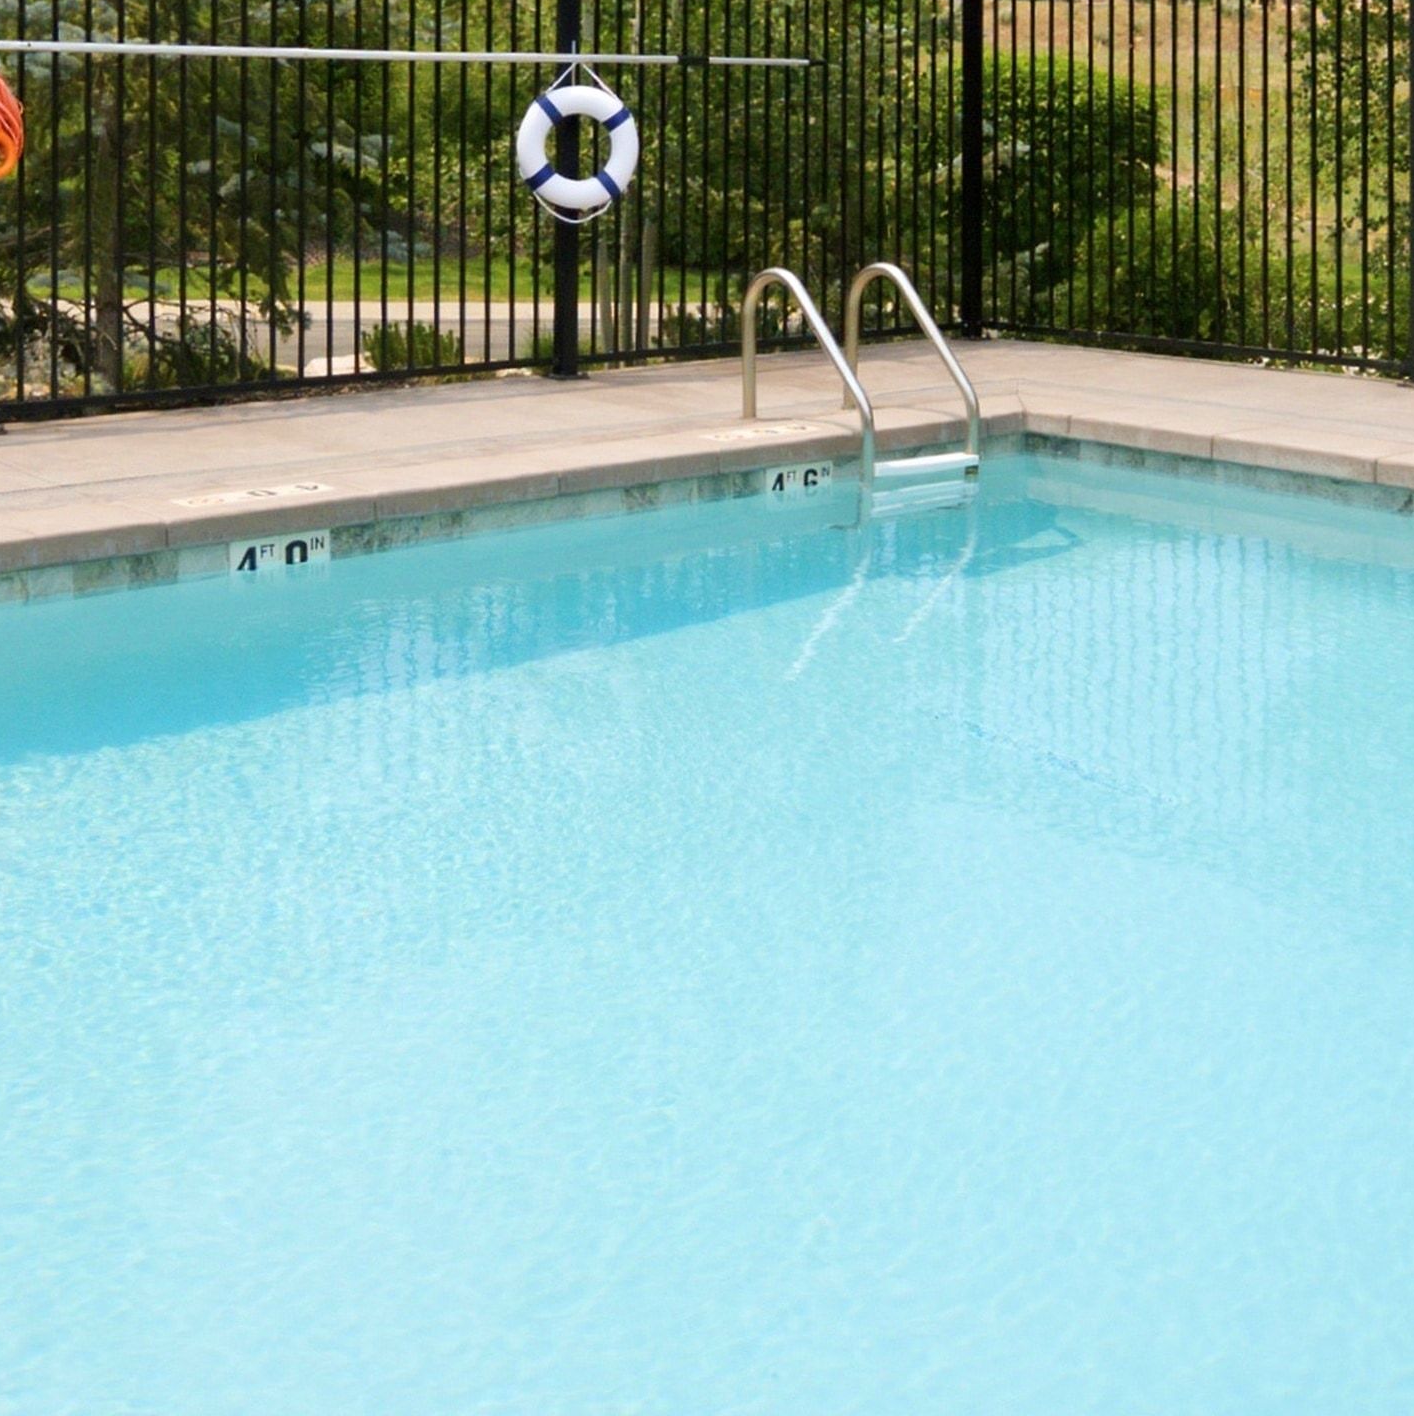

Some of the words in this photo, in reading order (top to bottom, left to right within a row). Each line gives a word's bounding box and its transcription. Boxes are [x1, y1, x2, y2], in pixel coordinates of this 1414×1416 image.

[236, 546, 257, 570] 4
[261, 544, 275, 558] FT
[310, 536, 325, 551] IN
